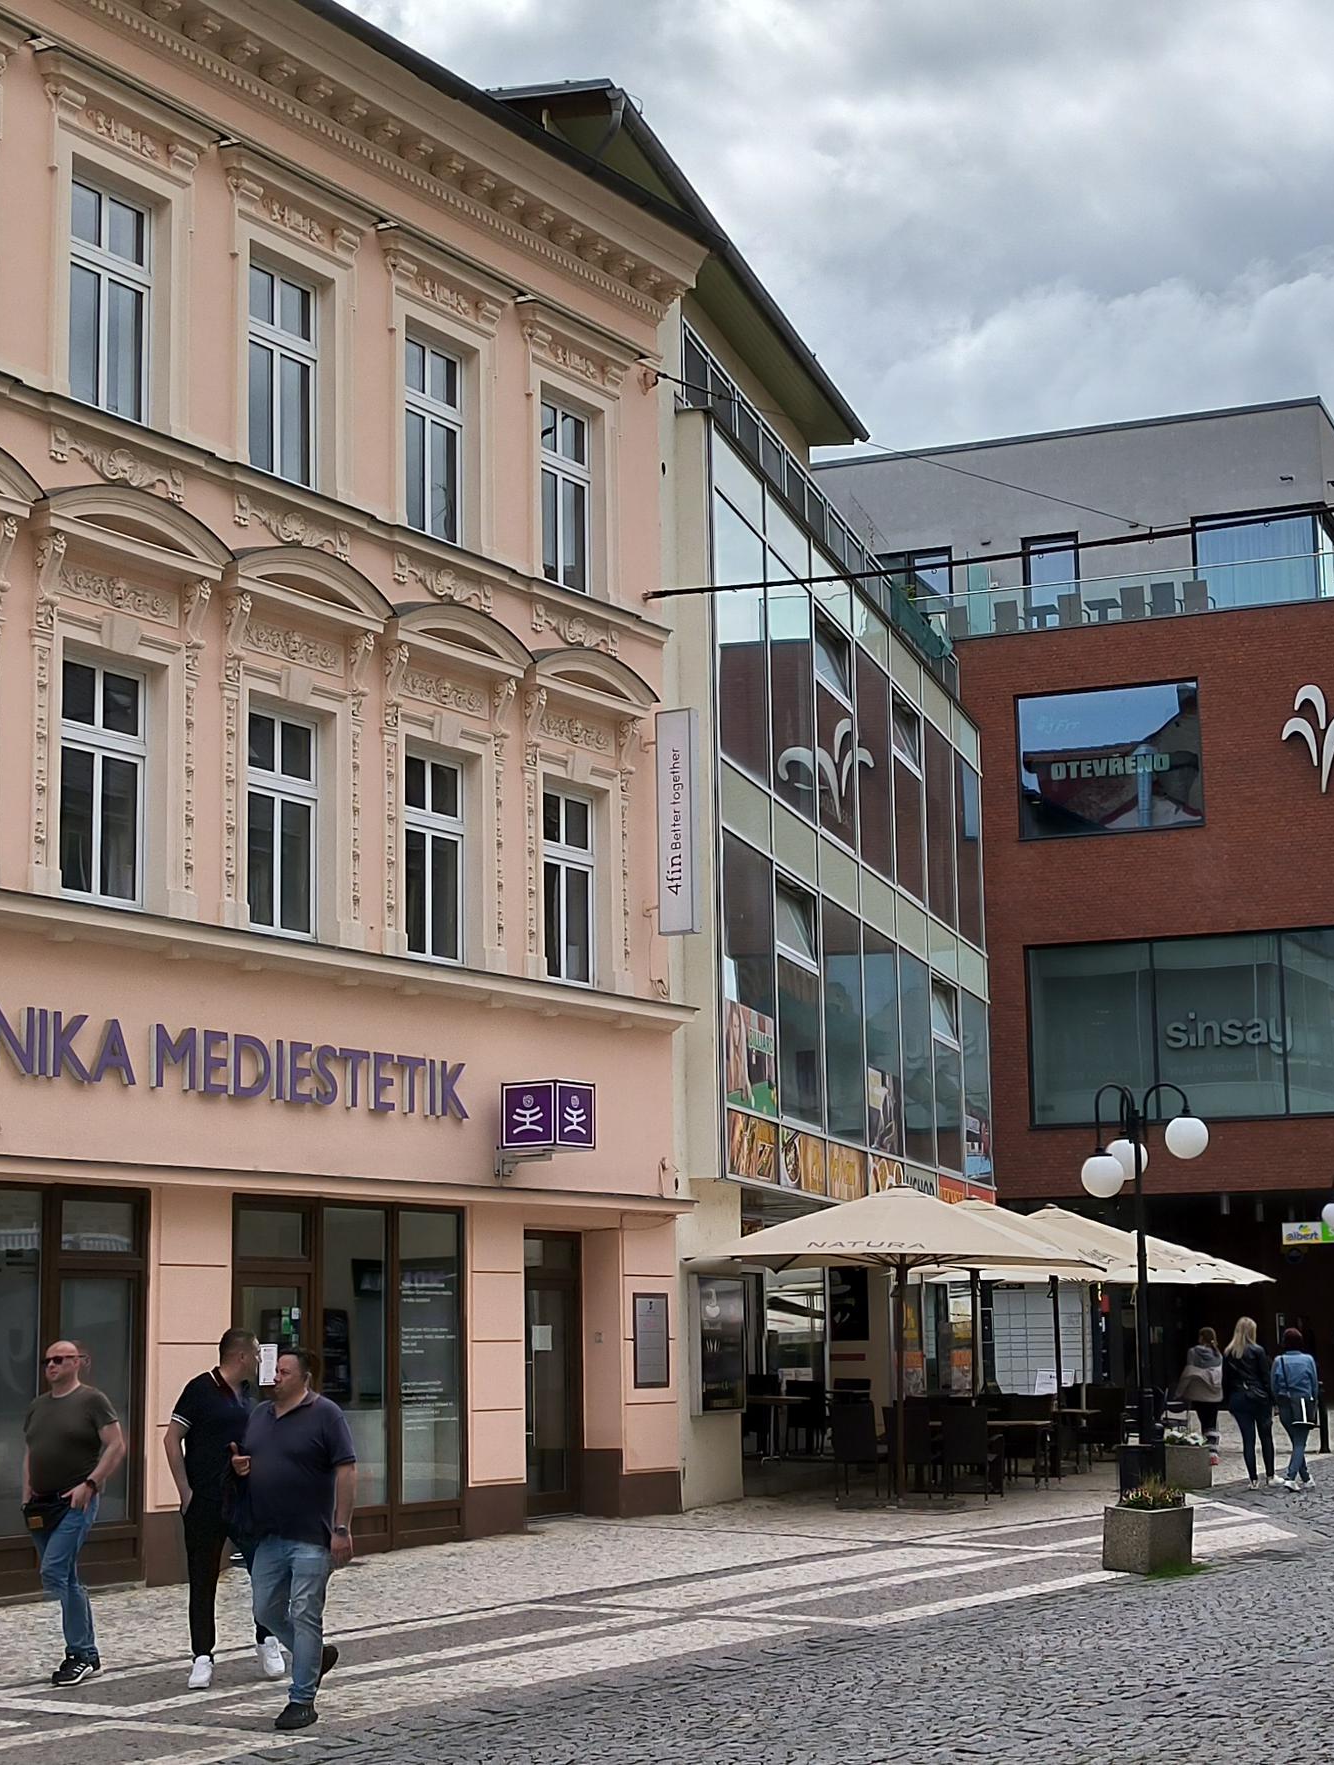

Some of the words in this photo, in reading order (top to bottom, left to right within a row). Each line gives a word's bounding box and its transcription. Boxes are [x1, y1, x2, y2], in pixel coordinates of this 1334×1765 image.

[670, 748, 684, 805] together
[670, 809, 682, 850] Better
[667, 853, 682, 896] 4fin
[1166, 1012, 1293, 1055] sinsay
[148, 1022, 469, 1120] MEDIESTETIK
[806, 1240, 927, 1250] NATURA
[1286, 1231, 1319, 1241] albert
